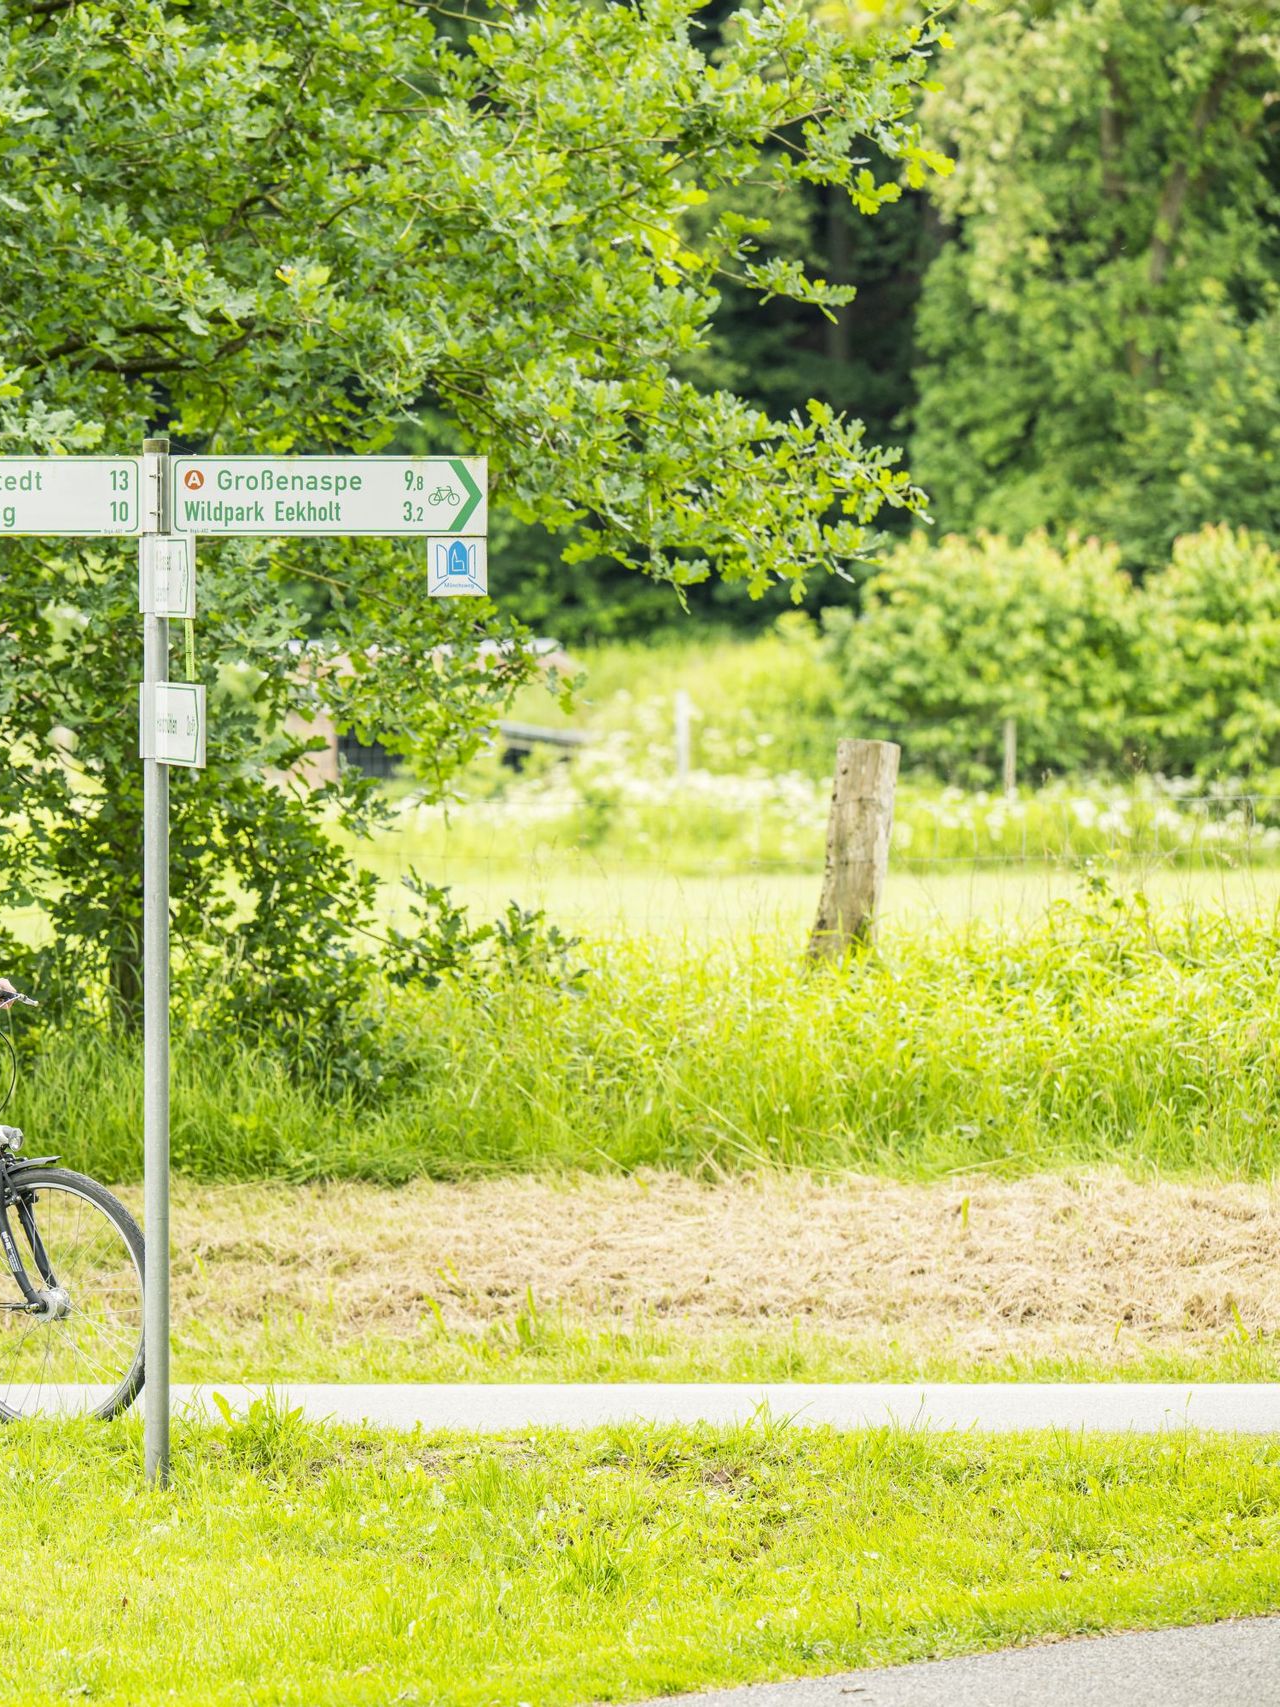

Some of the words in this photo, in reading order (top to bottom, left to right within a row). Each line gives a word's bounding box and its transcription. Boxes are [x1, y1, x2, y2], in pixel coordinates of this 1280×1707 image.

[110, 470, 129, 491] 13
[186, 470, 202, 490] A
[216, 469, 363, 496] Großenaspe
[404, 470, 424, 493] 9,8
[111, 501, 129, 522] 10
[184, 501, 264, 527] Wildpark
[274, 501, 341, 522] Eekholt
[403, 502, 424, 523] 3,2
